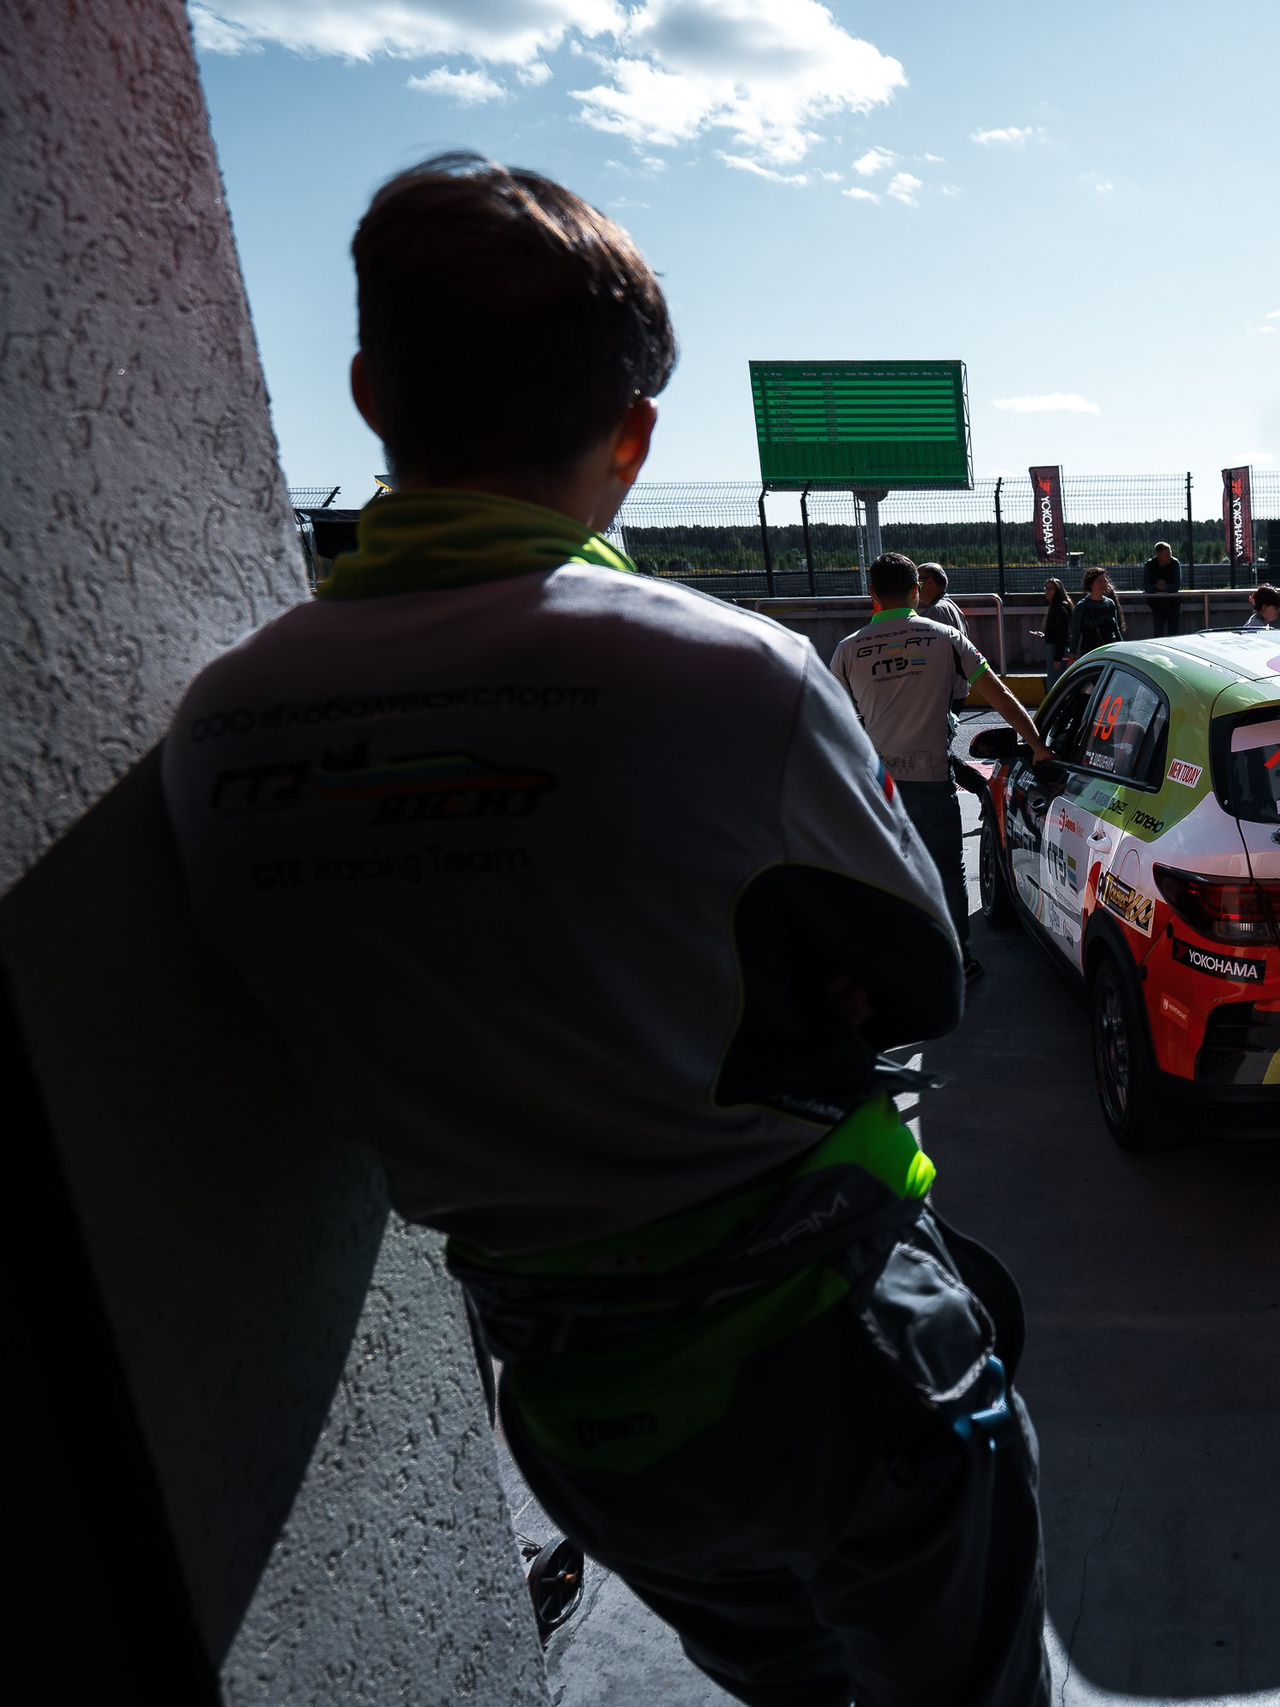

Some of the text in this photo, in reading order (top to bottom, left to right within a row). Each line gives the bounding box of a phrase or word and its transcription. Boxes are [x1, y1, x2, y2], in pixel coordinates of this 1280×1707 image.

[1041, 496, 1055, 555] YOKOHAMA
[1232, 497, 1243, 557] YOKOHAMA
[1094, 695, 1123, 741] 19
[1168, 760, 1201, 786] MEN TODAY
[250, 844, 530, 891] GTE Racing Team
[1189, 949, 1258, 979] YOKOHAMA
